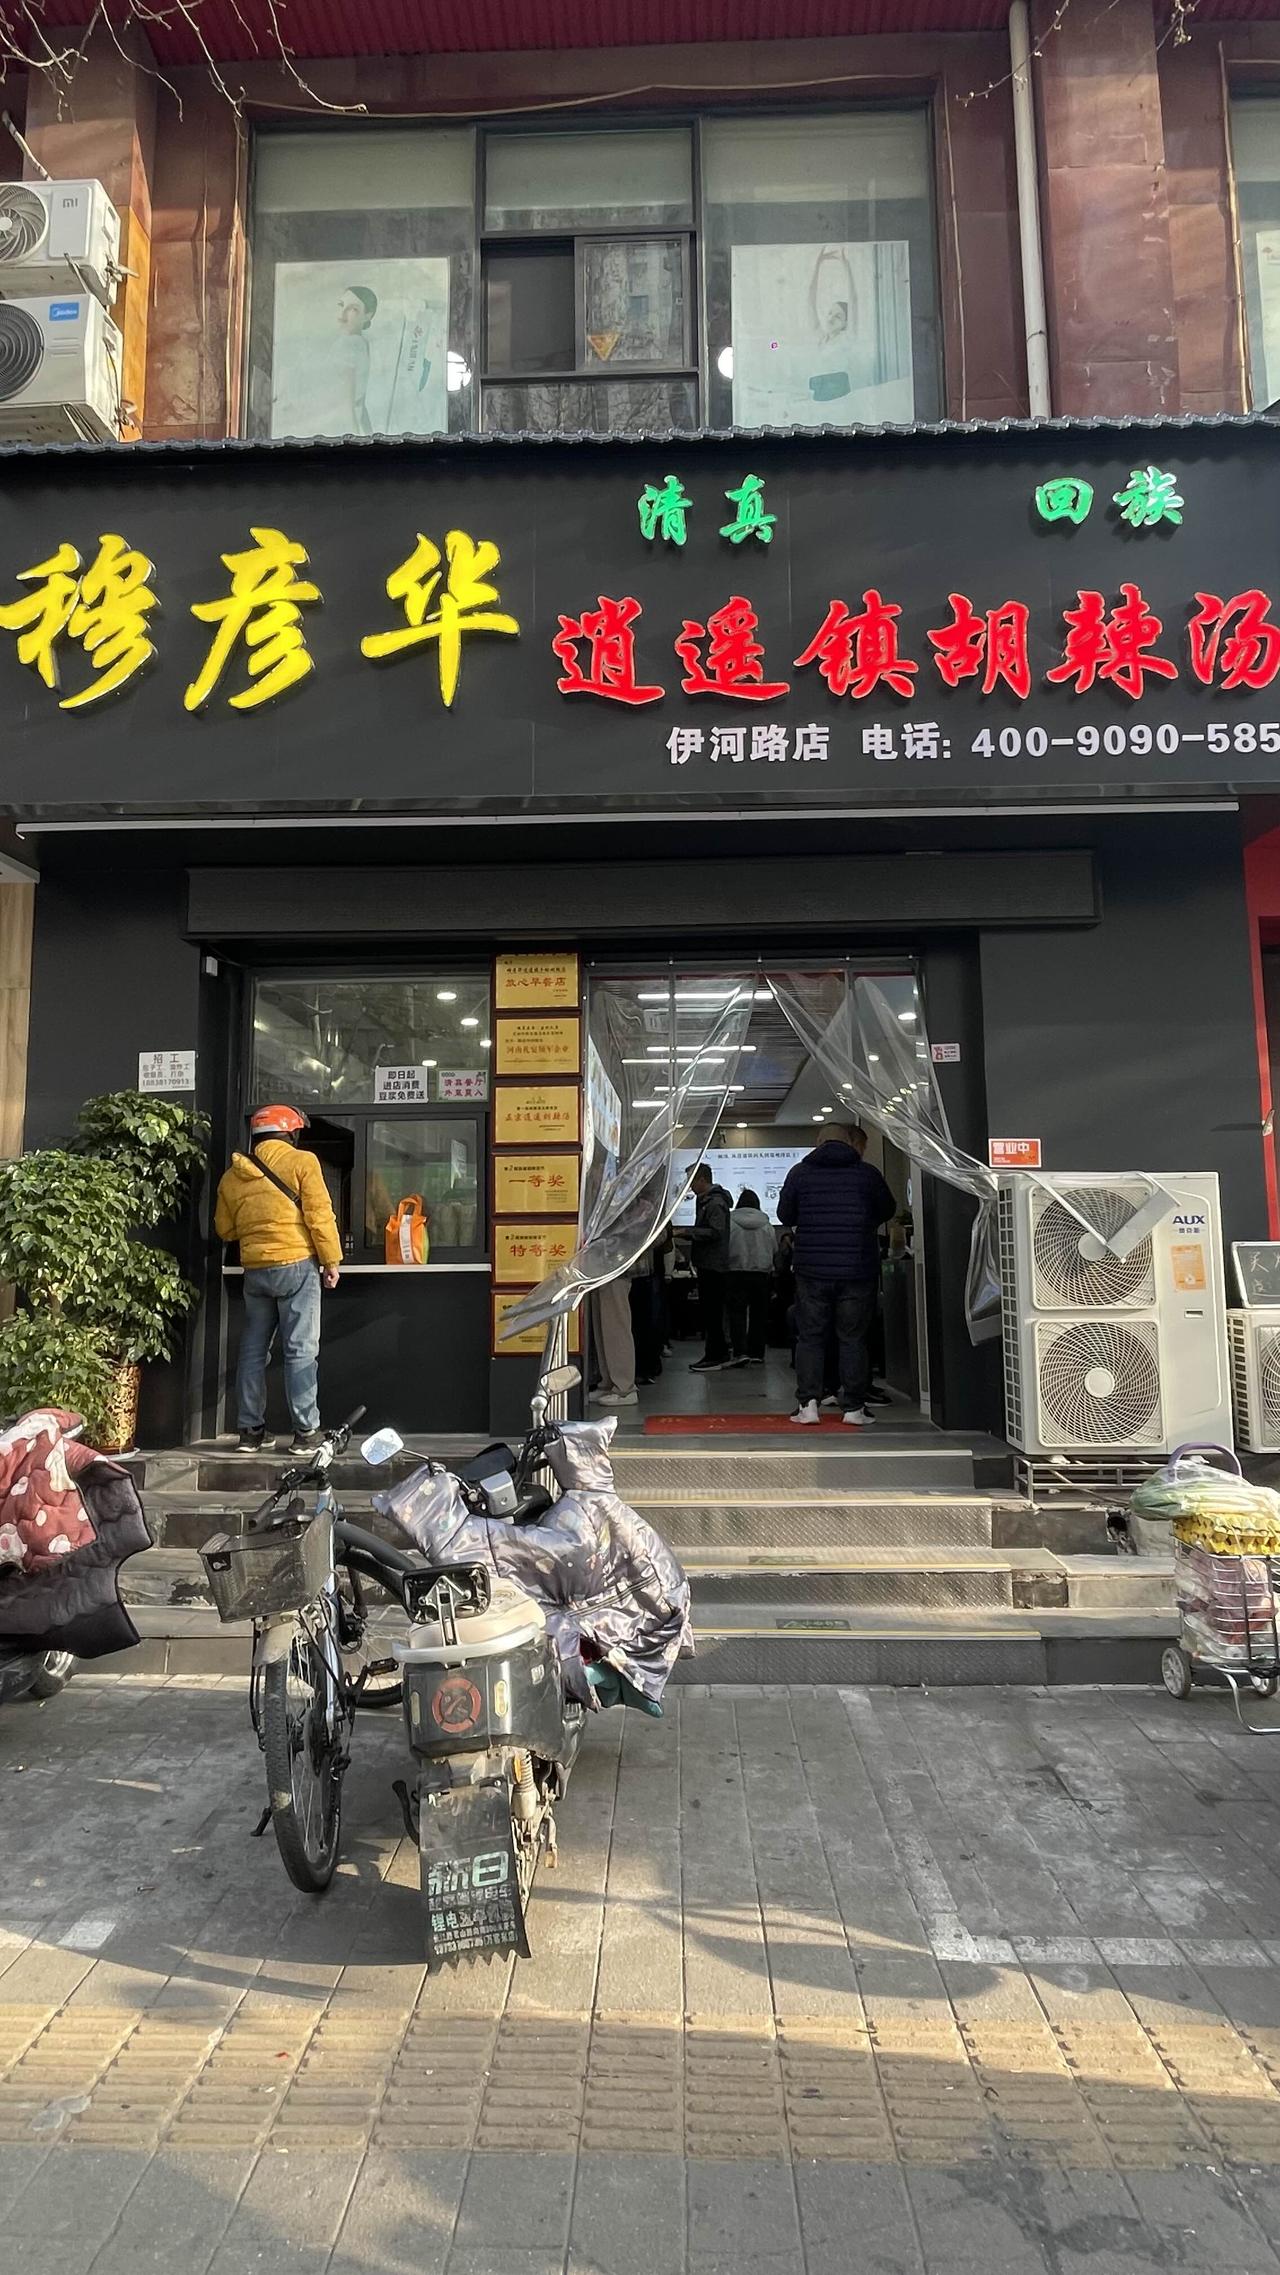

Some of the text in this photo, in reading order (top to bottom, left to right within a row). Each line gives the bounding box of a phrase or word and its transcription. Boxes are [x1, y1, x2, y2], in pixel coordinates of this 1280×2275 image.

[1034, 466, 1185, 526] 回族
[638, 474, 778, 545] 清真
[0, 527, 521, 711] 穆彦华
[552, 584, 1280, 705] 逍遥镇胡辣汤
[666, 723, 830, 765] 伊河路店
[970, 721, 1280, 758] 400-9090-585
[505, 976, 567, 988] 放心早餐店
[153, 1053, 180, 1064] 招工
[387, 1069, 416, 1080] 即日起
[383, 1080, 420, 1091] 进店消费
[444, 1078, 484, 1087] 清真餐厅
[378, 1090, 425, 1102] 豆浆免费送
[992, 1142, 1030, 1155] 营业中
[508, 1173, 566, 1188] 一等奖
[1172, 1215, 1206, 1226] AUX
[509, 1242, 567, 1257] 特等奖
[427, 1850, 510, 1897] 新日
